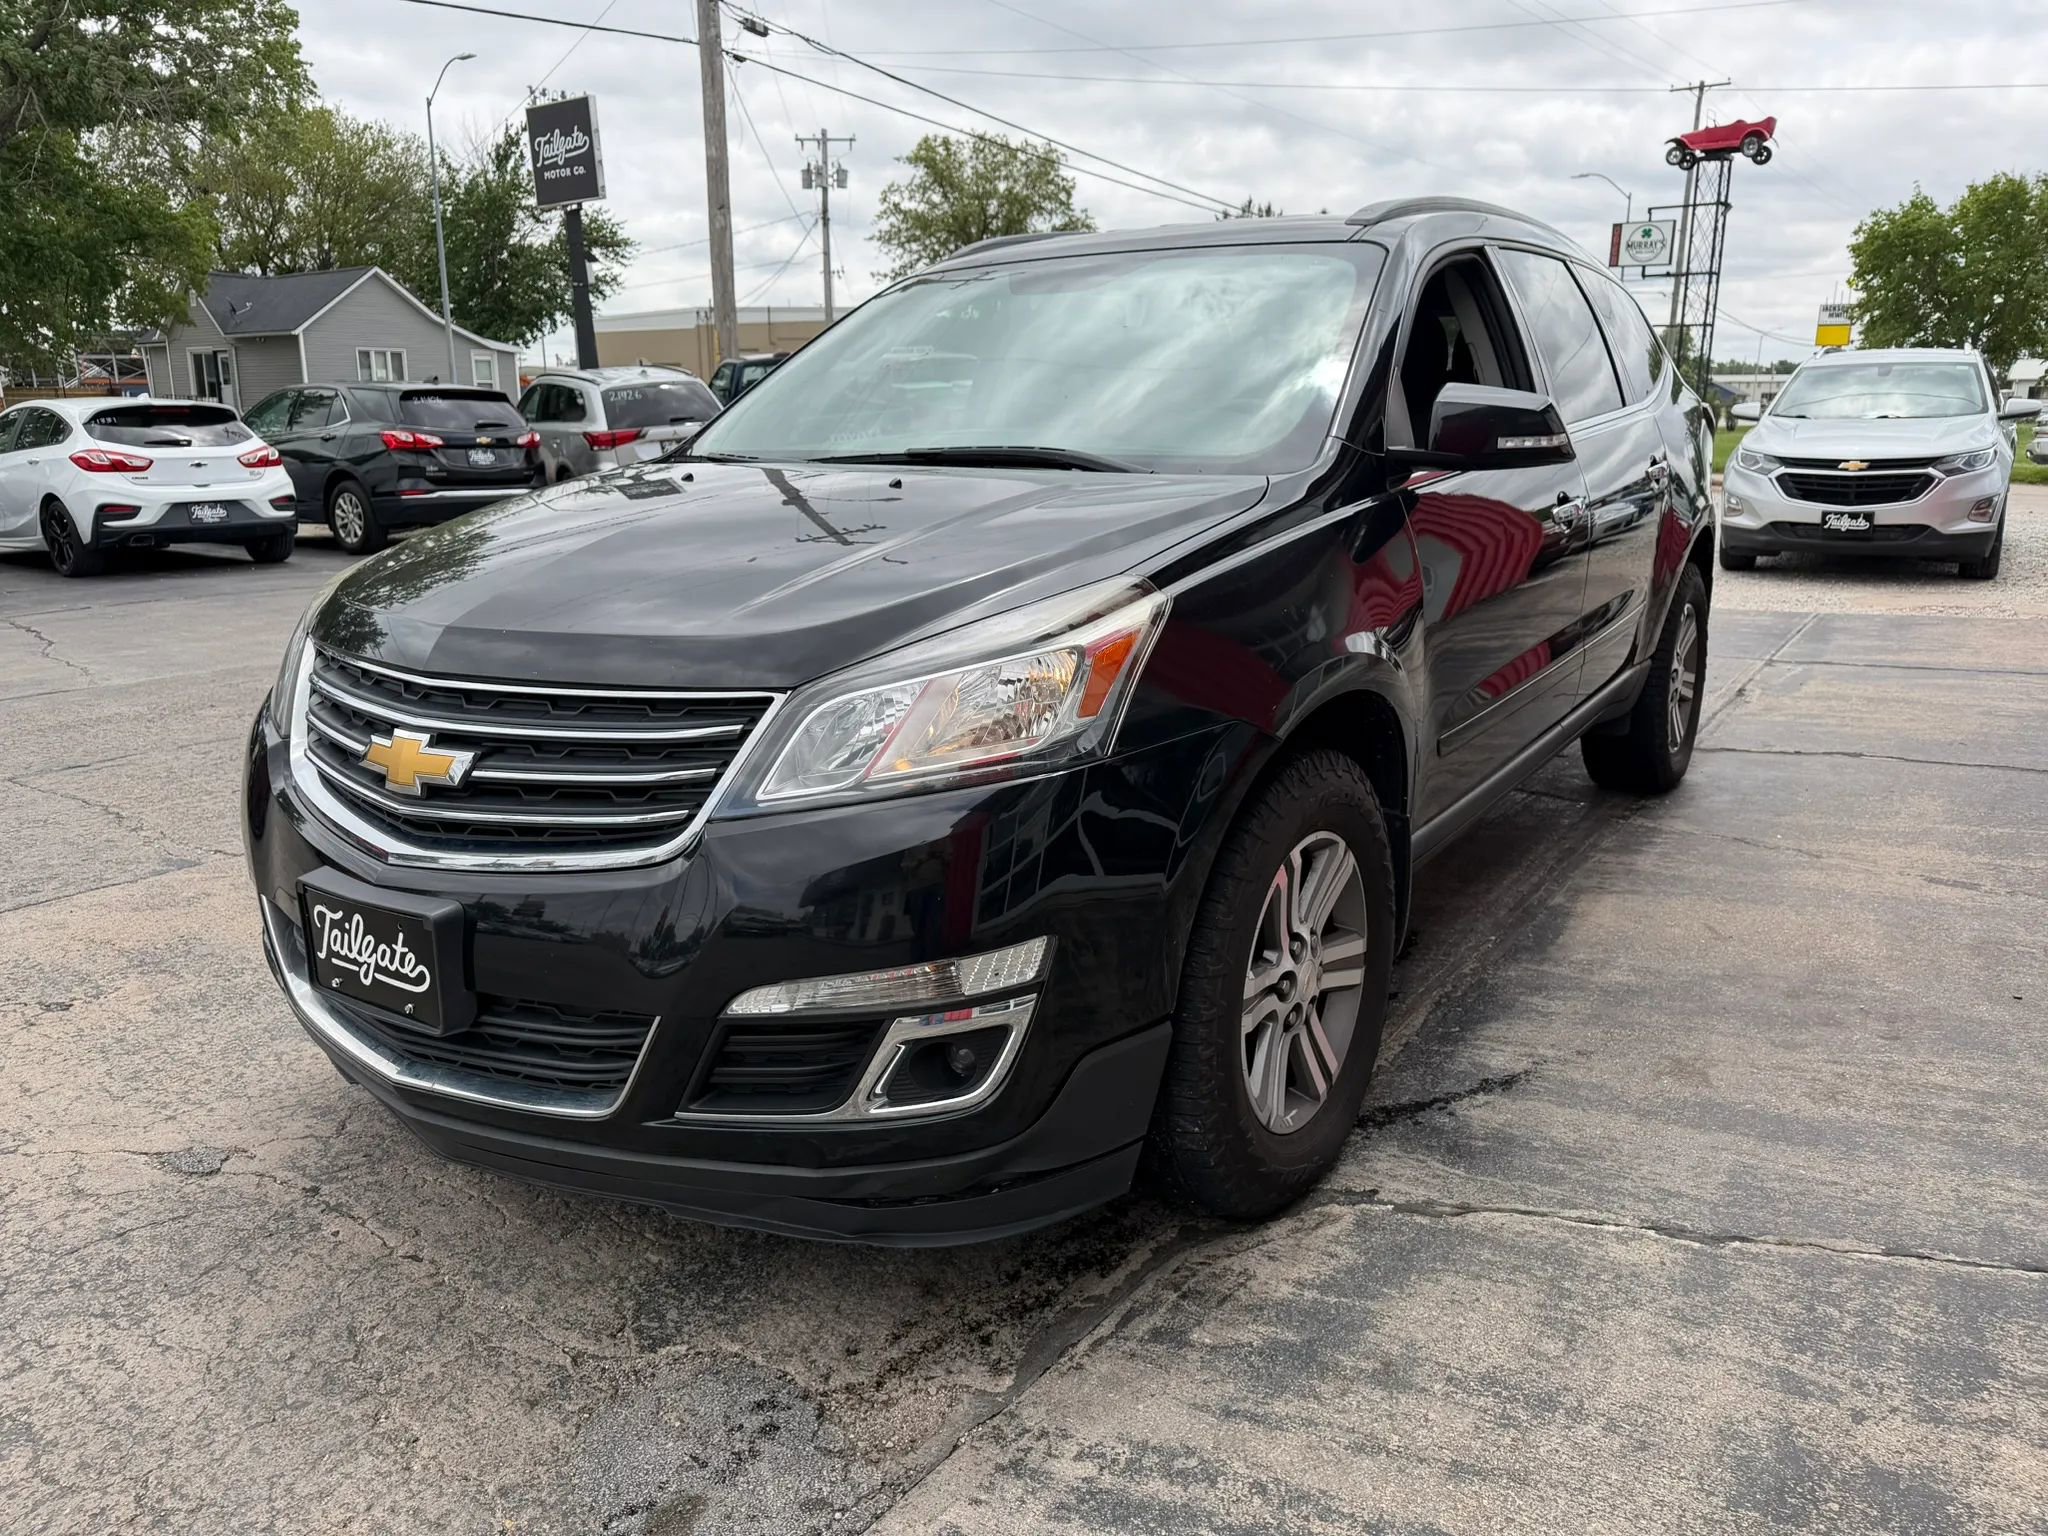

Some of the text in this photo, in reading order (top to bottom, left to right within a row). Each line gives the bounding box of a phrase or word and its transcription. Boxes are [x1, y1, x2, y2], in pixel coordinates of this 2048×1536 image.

[534, 125, 590, 167] Tailgate
[543, 165, 587, 180] MOTOR CO.
[1625, 237, 1668, 251] MURRAY'S
[191, 503, 227, 520] Tailgate
[1823, 512, 1870, 532] Tailgate
[313, 904, 431, 993] Tailgate
